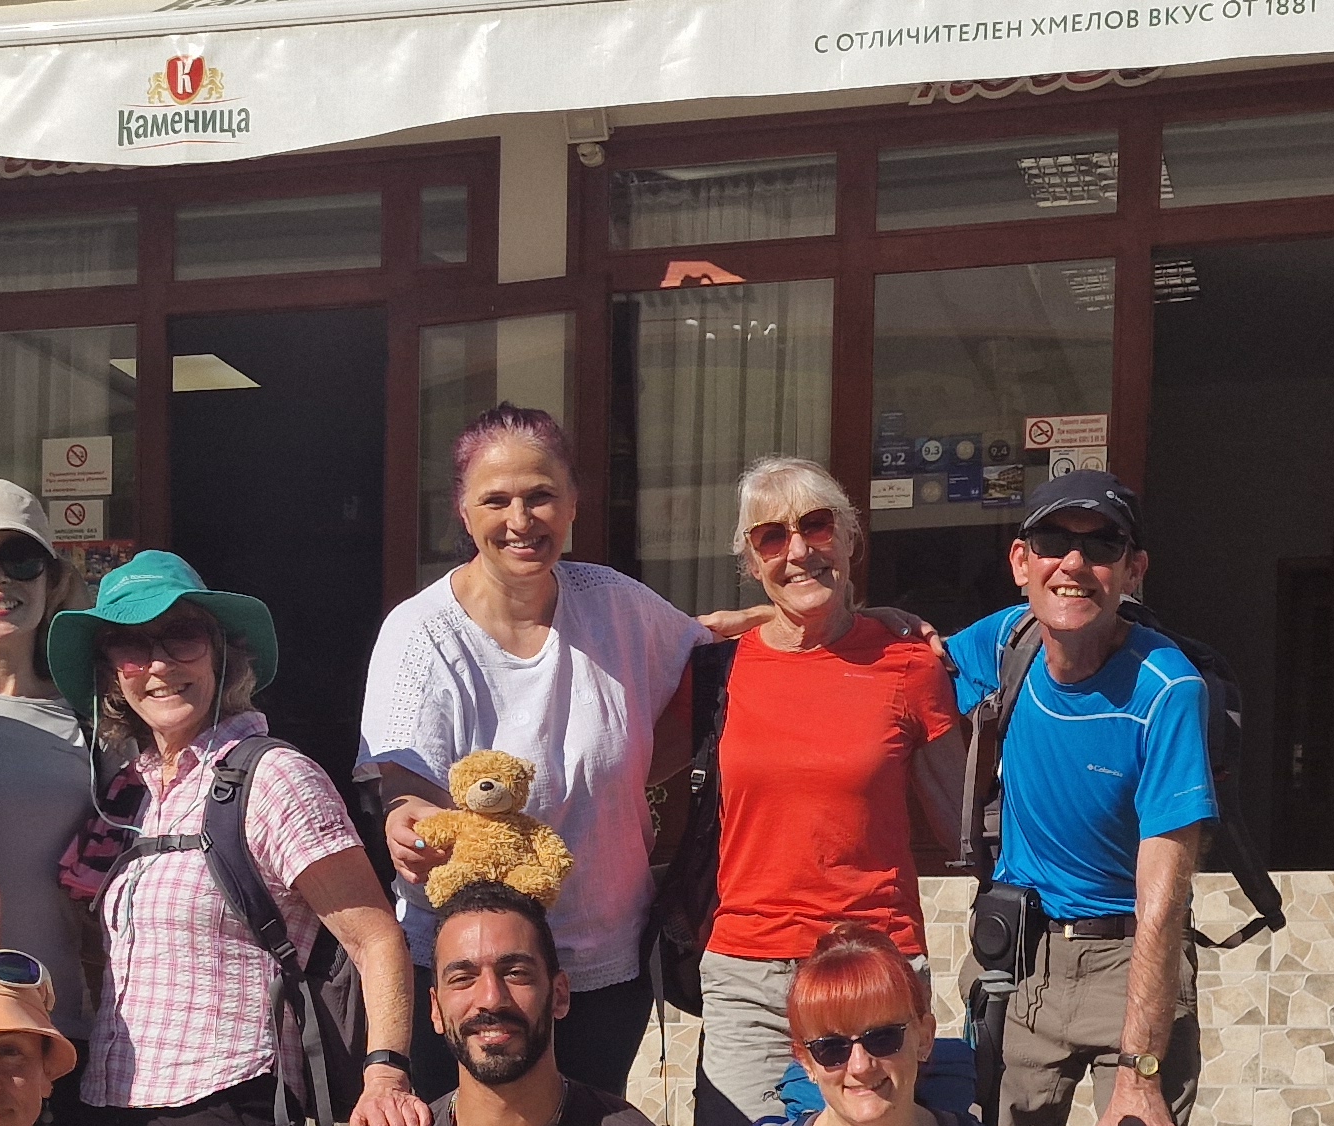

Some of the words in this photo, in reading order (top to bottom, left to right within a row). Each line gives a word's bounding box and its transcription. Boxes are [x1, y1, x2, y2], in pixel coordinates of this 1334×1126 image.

[814, 34, 829, 54] С
[836, 19, 1022, 52] ОТЛИЧИТЕЛЕН
[1030, 10, 1139, 36] ХМЕЛОВ
[1148, 3, 1215, 27] ВКУС
[1222, 0, 1256, 19] ОТ
[1267, 0, 1316, 16] 1881
[176, 59, 193, 95] К
[117, 107, 251, 147] Каменица
[882, 452, 906, 466] 9.2
[923, 445, 940, 456] 9.3
